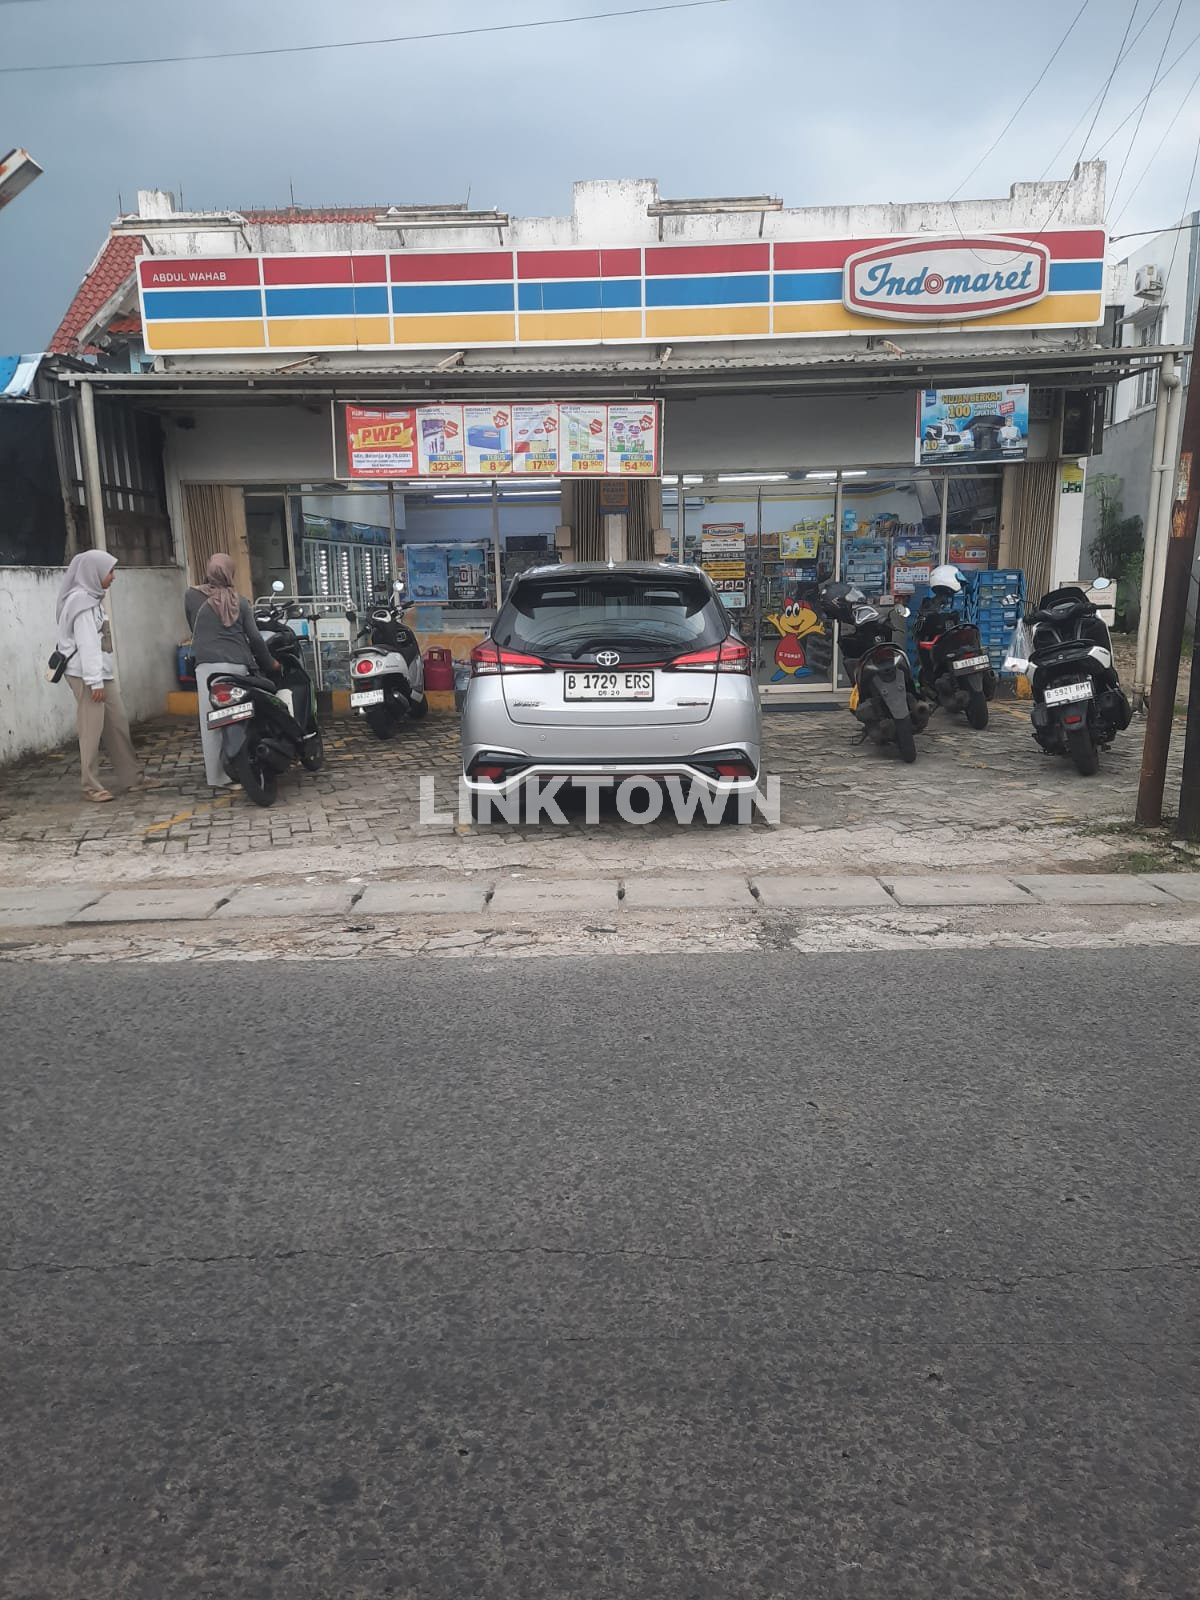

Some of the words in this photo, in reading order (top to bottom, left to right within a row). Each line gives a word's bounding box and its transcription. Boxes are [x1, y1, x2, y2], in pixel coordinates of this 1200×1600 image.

[152, 272, 186, 282] ABDUL
[189, 271, 226, 281] WAHAB
[859, 261, 1033, 297] Indomaret
[949, 404, 971, 418] 100
[362, 426, 401, 443] PWP
[926, 439, 939, 450] 10
[568, 675, 576, 689] B
[584, 675, 617, 689] 1729
[625, 674, 651, 688] ERS
